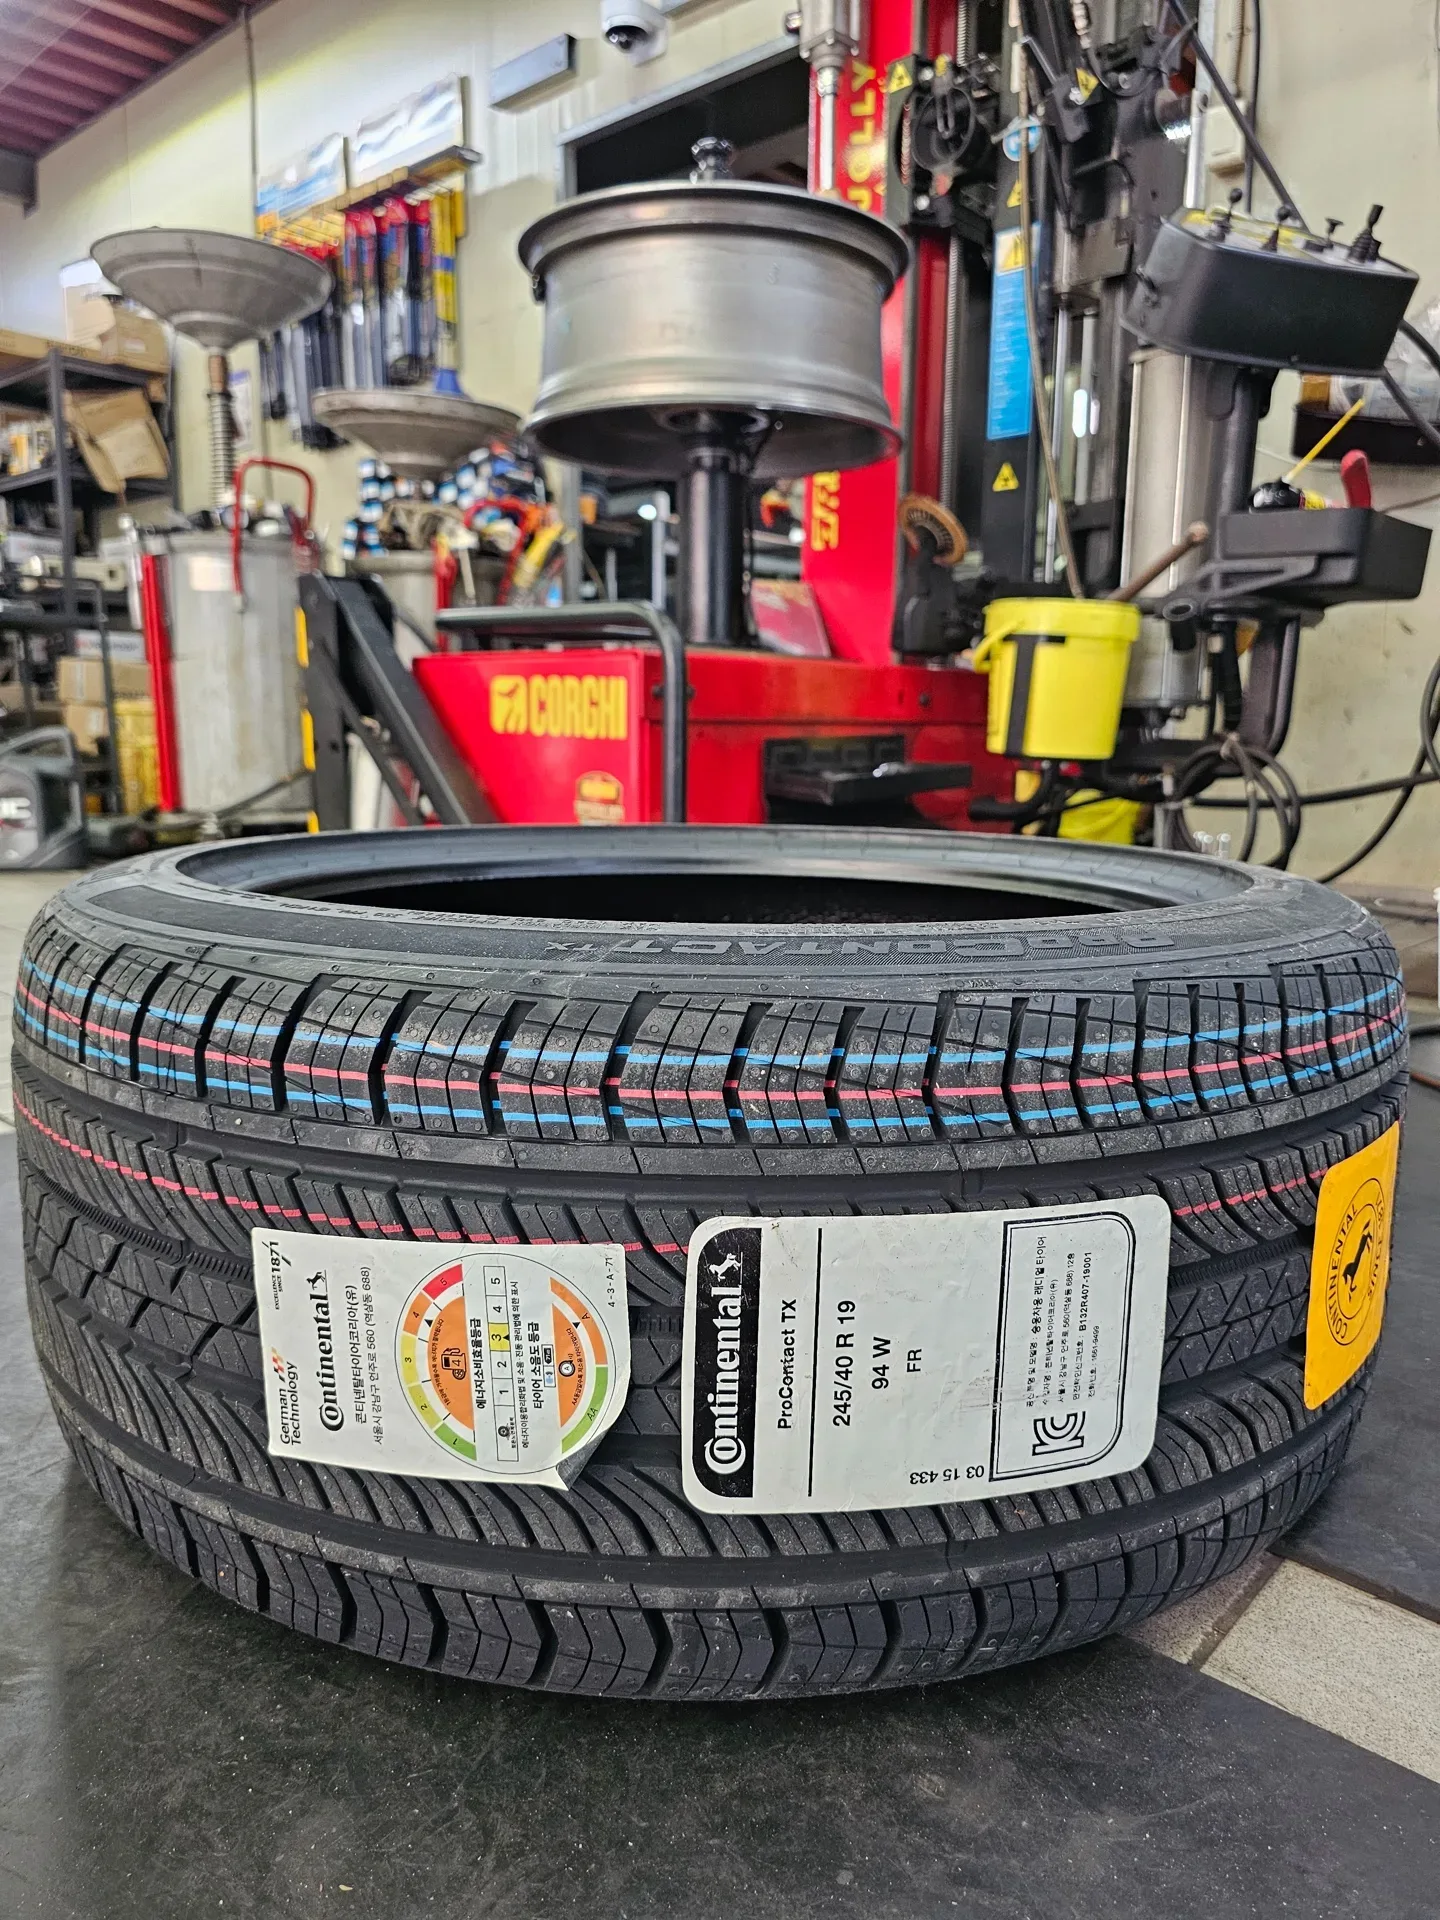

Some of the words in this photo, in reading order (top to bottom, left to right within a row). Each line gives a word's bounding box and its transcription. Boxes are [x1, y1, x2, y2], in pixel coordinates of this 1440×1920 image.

[847, 60, 877, 212] JOLLY
[528, 674, 628, 740] CORGHI
[269, 1241, 281, 1273] 1871
[1035, 1236, 1047, 1265] 타이어
[360, 1266, 371, 1292] 688)
[440, 1277, 448, 1286] 5
[490, 1277, 501, 1285] 5
[1328, 1203, 1358, 1339] CONTINENTAL
[271, 1274, 280, 1310] EXCELLENCE
[510, 1281, 519, 1296] 표시
[1078, 1252, 1092, 1332] B132R407-19001
[362, 1293, 376, 1327] (역삼동
[413, 1311, 420, 1319] 4
[493, 1305, 503, 1313] 4
[511, 1297, 520, 1312] 의한
[581, 1312, 591, 1320] A
[781, 1299, 797, 1323] TX
[837, 1300, 856, 1325] 19
[366, 1329, 376, 1350] 560
[491, 1333, 501, 1342] 3
[512, 1313, 522, 1341] 관리법에
[527, 1321, 540, 1343] 등급
[835, 1333, 855, 1348] R
[872, 1336, 891, 1359] W
[309, 1293, 345, 1432] Continental
[345, 1285, 367, 1424] 콘티넨탈타이어코리아(유)
[367, 1352, 379, 1381] 언주로
[452, 1359, 461, 1367] 4
[469, 1318, 487, 1409] 에너지소비효율등급
[497, 1360, 507, 1368] 2
[529, 1346, 541, 1377] 소음도
[906, 1348, 922, 1373] FR
[704, 1284, 746, 1475] Continental
[777, 1328, 796, 1429] ProContact
[871, 1364, 890, 1390] 94
[286, 1361, 301, 1446] Technology
[370, 1384, 382, 1413] 강남구
[531, 1378, 544, 1409] 타이어
[832, 1355, 853, 1427] 245/40
[279, 1388, 290, 1445] German
[420, 1403, 428, 1411] 2
[586, 1407, 598, 1421] AA
[372, 1415, 383, 1445] 서울시
[909, 1470, 939, 1485] 433
[942, 1468, 961, 1482] 15
[965, 1464, 985, 1480] 03
